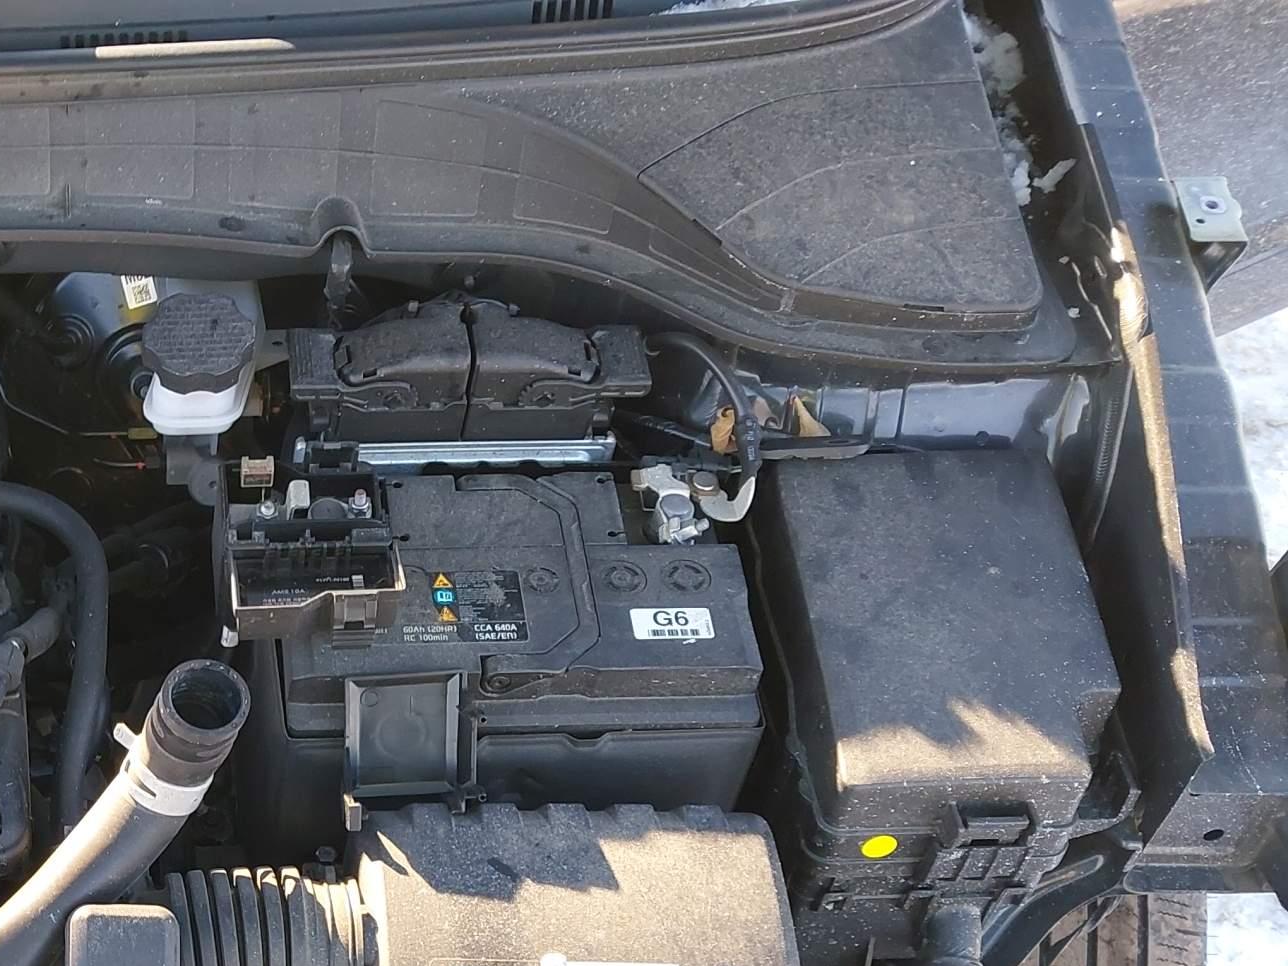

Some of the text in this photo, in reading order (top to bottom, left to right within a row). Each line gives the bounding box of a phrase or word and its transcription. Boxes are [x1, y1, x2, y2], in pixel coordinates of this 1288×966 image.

[652, 610, 689, 627] G6
[403, 625, 457, 633] 60Ah (20HR)
[474, 624, 518, 632] CCA 640A
[403, 634, 449, 642] RC 100min
[475, 632, 518, 640] (SAE/EN)
